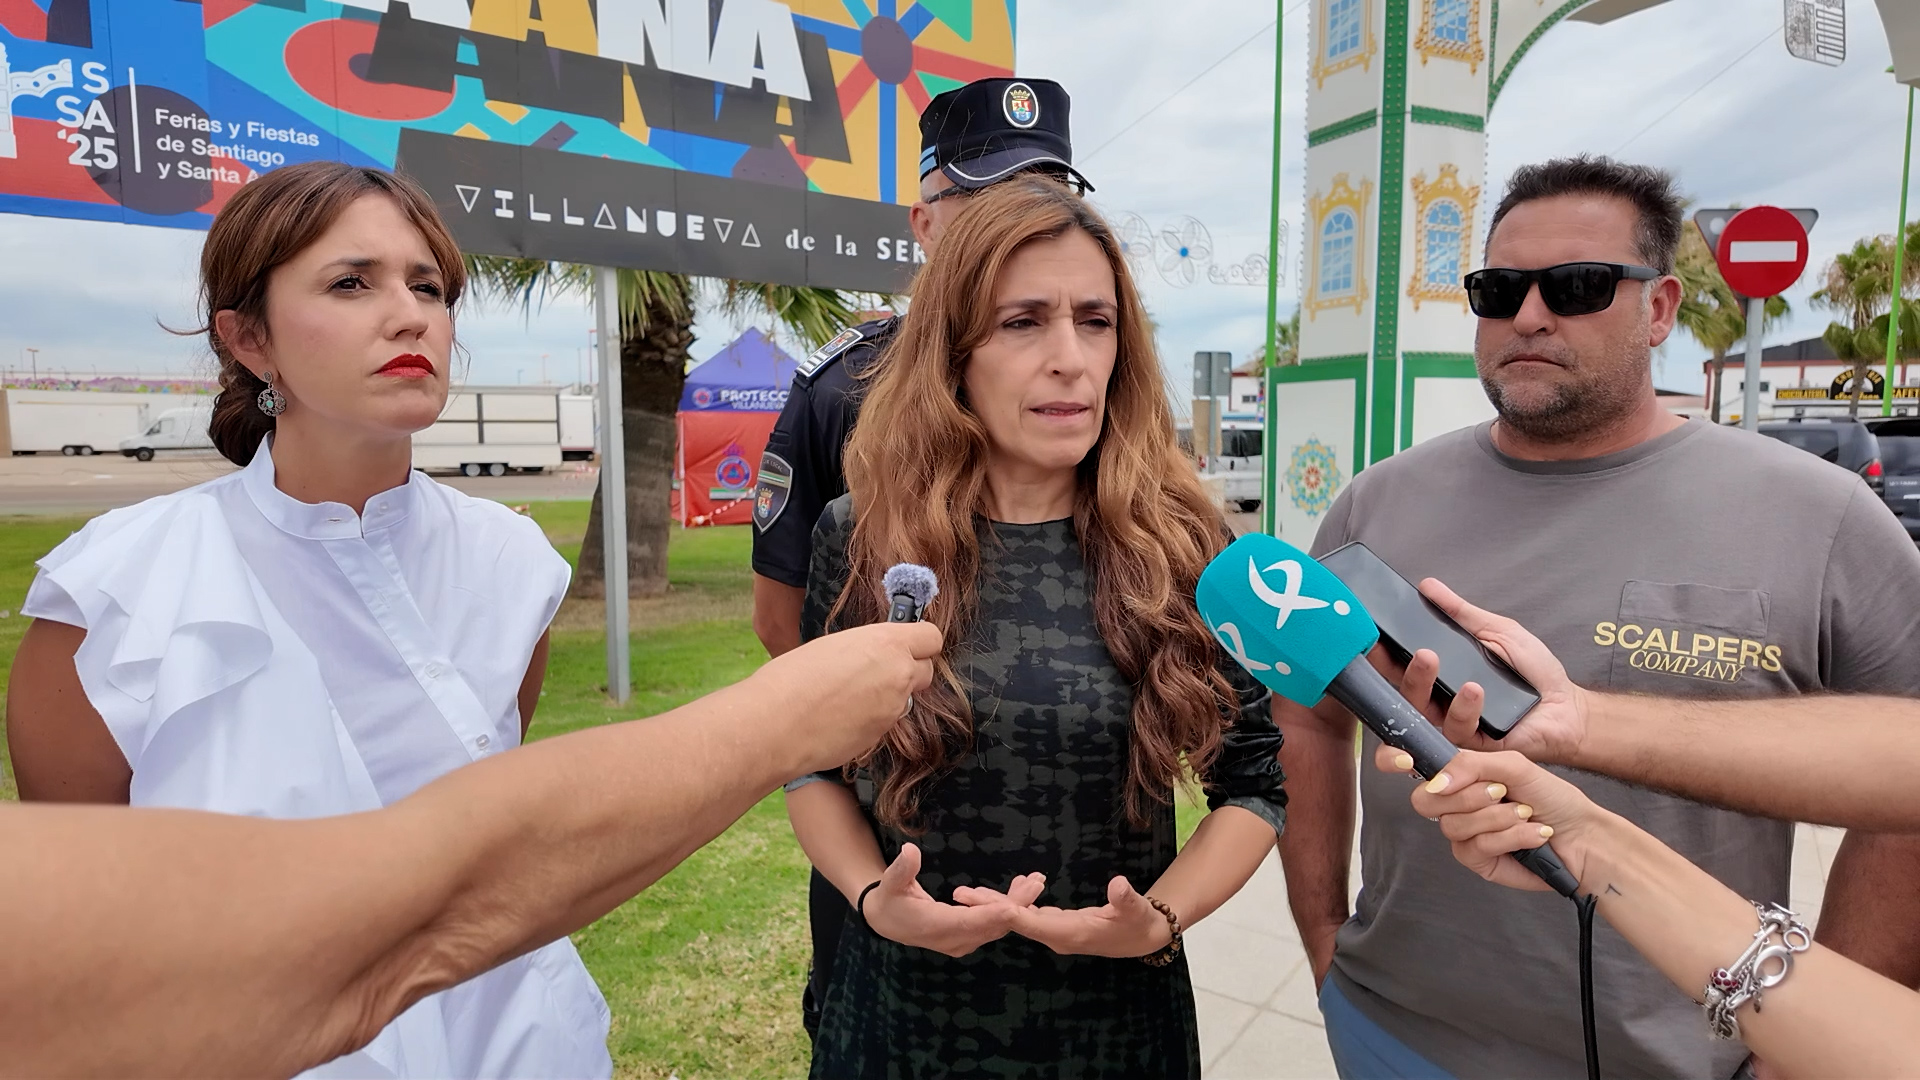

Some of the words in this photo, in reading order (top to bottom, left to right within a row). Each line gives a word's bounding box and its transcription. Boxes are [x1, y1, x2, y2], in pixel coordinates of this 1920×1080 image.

[81, 61, 110, 94] S
[56, 95, 116, 134] SA
[154, 107, 223, 133] Ferias
[228, 121, 241, 140] y
[246, 121, 320, 147] Fiestas
[156, 134, 186, 153] de
[191, 137, 285, 168] Santiago
[157, 161, 171, 180] y
[177, 160, 241, 184] Santa
[454, 183, 762, 248] VILLANUEVA
[784, 227, 816, 251] de
[834, 233, 858, 257] la
[1593, 621, 1783, 673] SCALPERS
[1628, 648, 1747, 682] COMPANY
